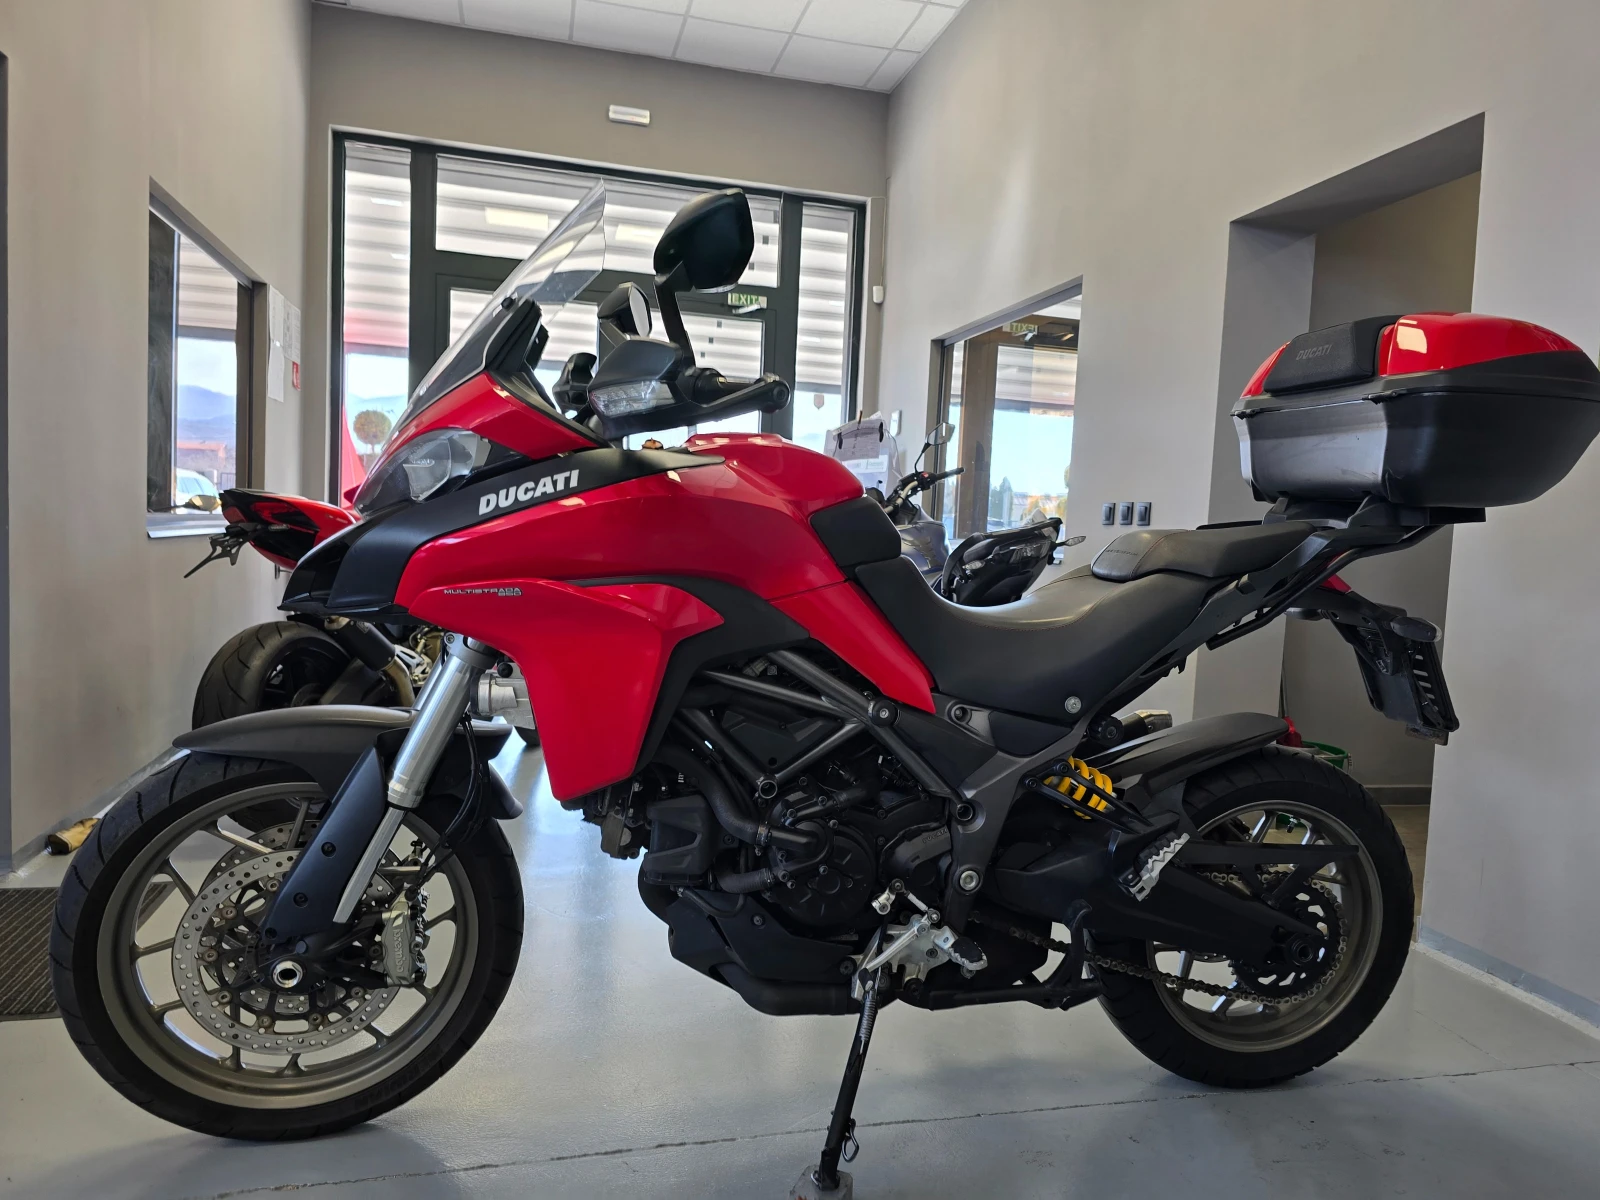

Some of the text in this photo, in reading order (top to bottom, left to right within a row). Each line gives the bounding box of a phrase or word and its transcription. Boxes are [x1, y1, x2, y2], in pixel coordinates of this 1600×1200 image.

[732, 293, 758, 305] EXIT
[1296, 344, 1333, 361] DUCATI
[478, 469, 580, 516] DUCATI
[393, 928, 405, 973] brembo
